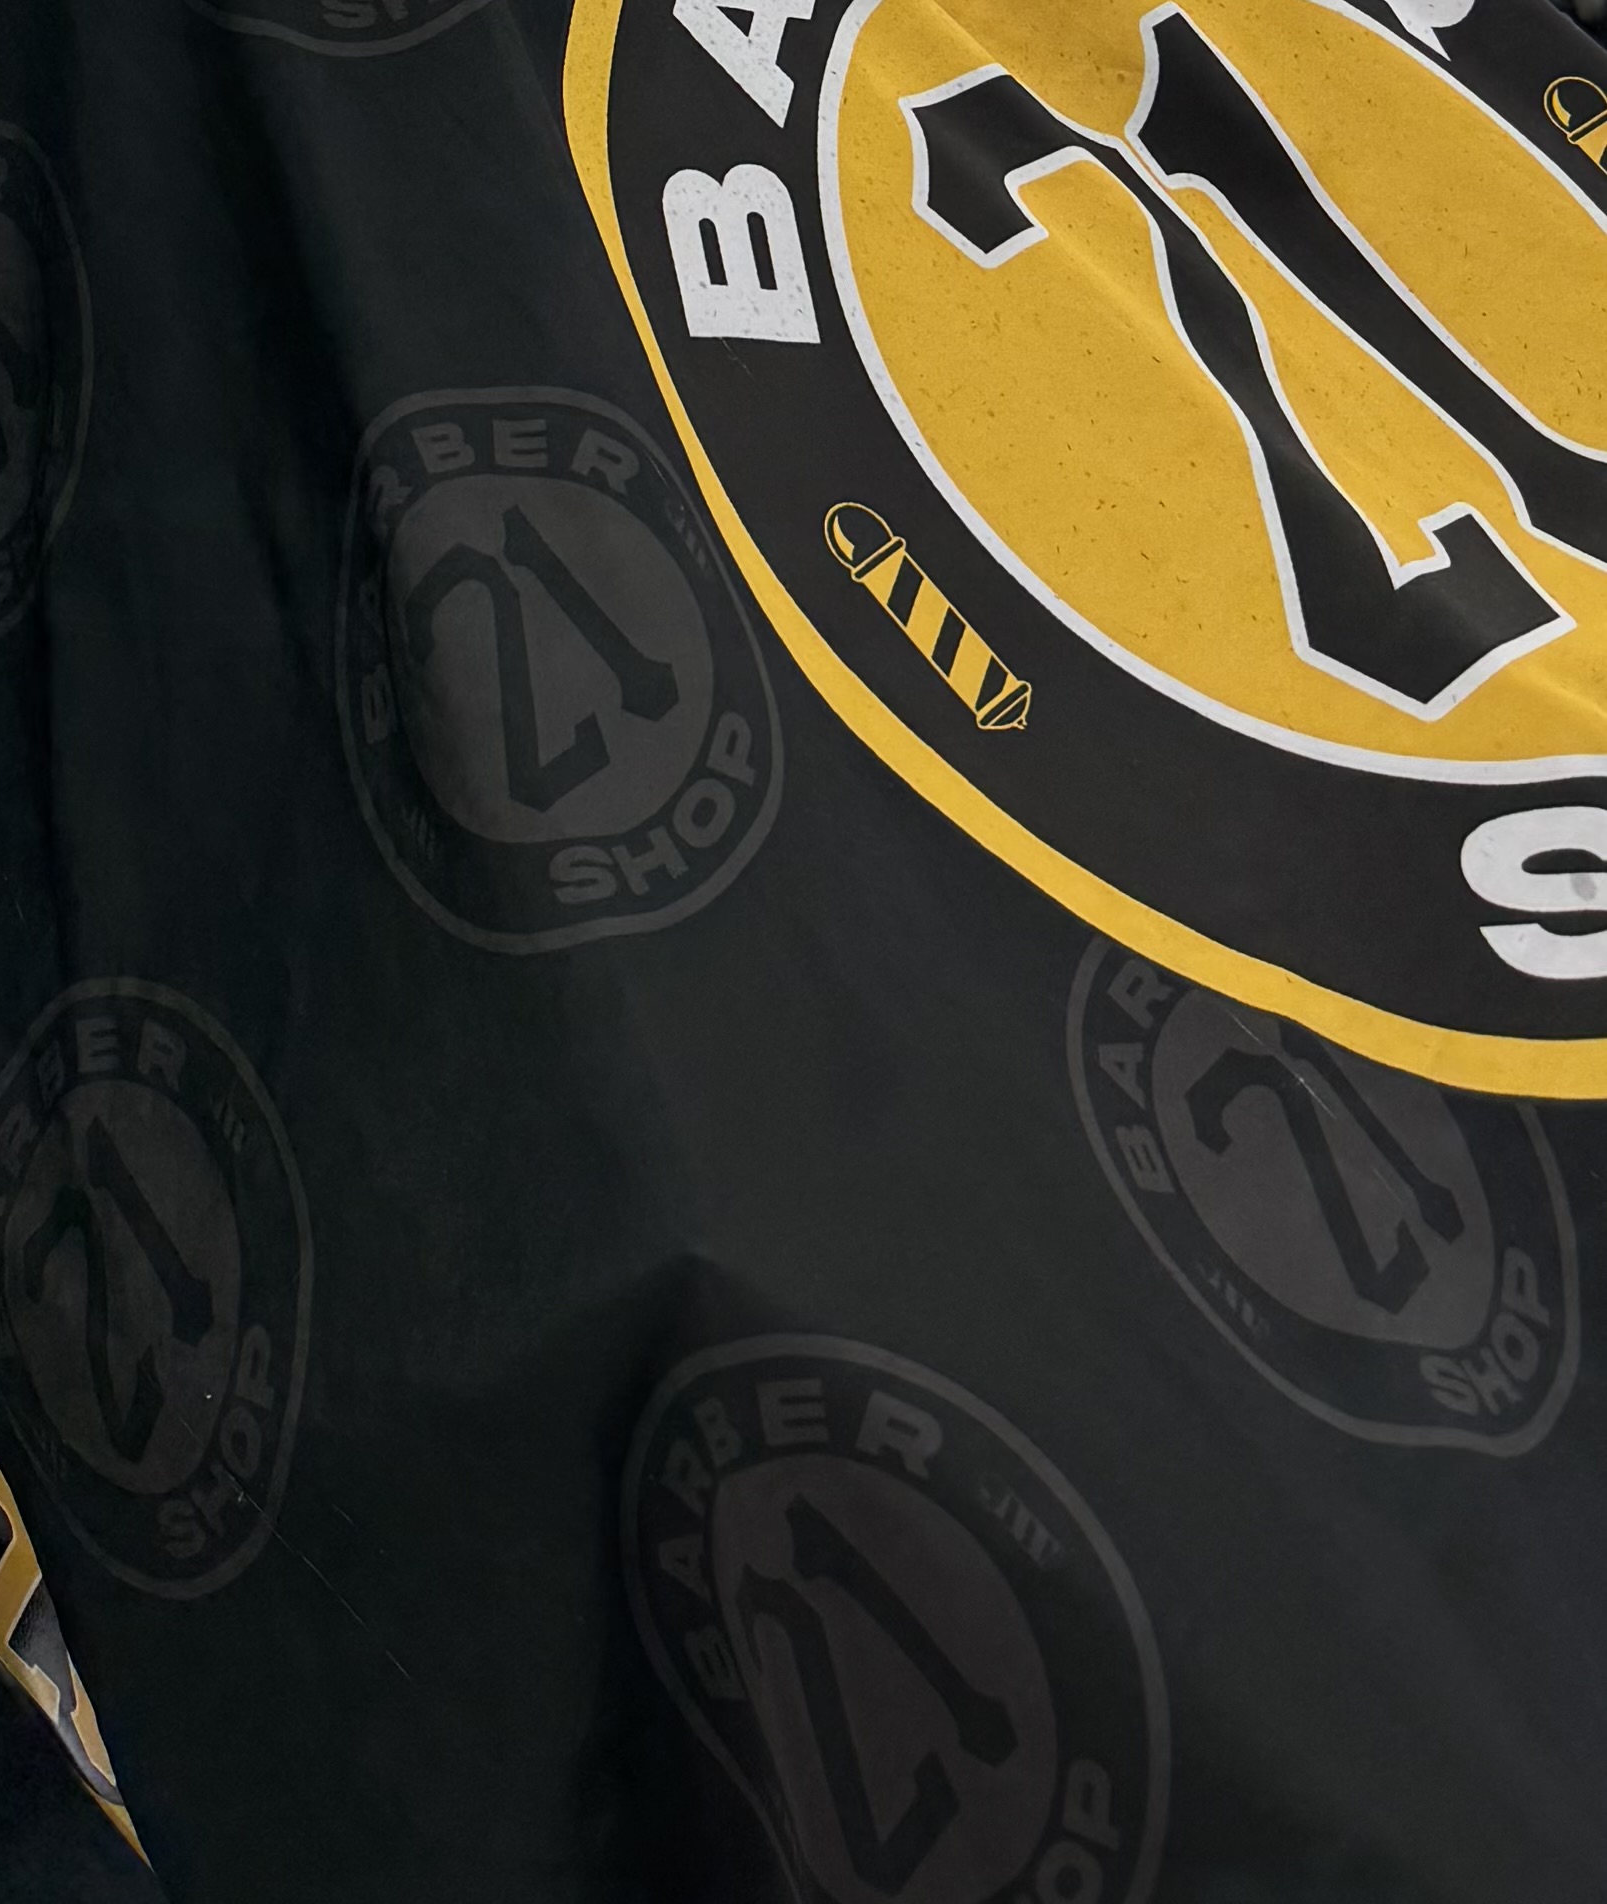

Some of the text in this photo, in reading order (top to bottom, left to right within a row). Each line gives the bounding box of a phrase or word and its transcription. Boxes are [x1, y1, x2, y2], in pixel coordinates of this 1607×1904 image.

[897, 3, 1607, 720] 21
[405, 505, 679, 813] 21
[549, 711, 754, 905] SHOP
[1099, 959, 1176, 1194] BAR
[1185, 1020, 1465, 1314] 21
[25, 1117, 213, 1462] 21
[1418, 1247, 1550, 1415] SHOP
[156, 1324, 274, 1559] SHOP
[658, 1378, 944, 1701] BARBER
[736, 1493, 1018, 1896] 21
[1019, 1759, 1119, 1904] OP
